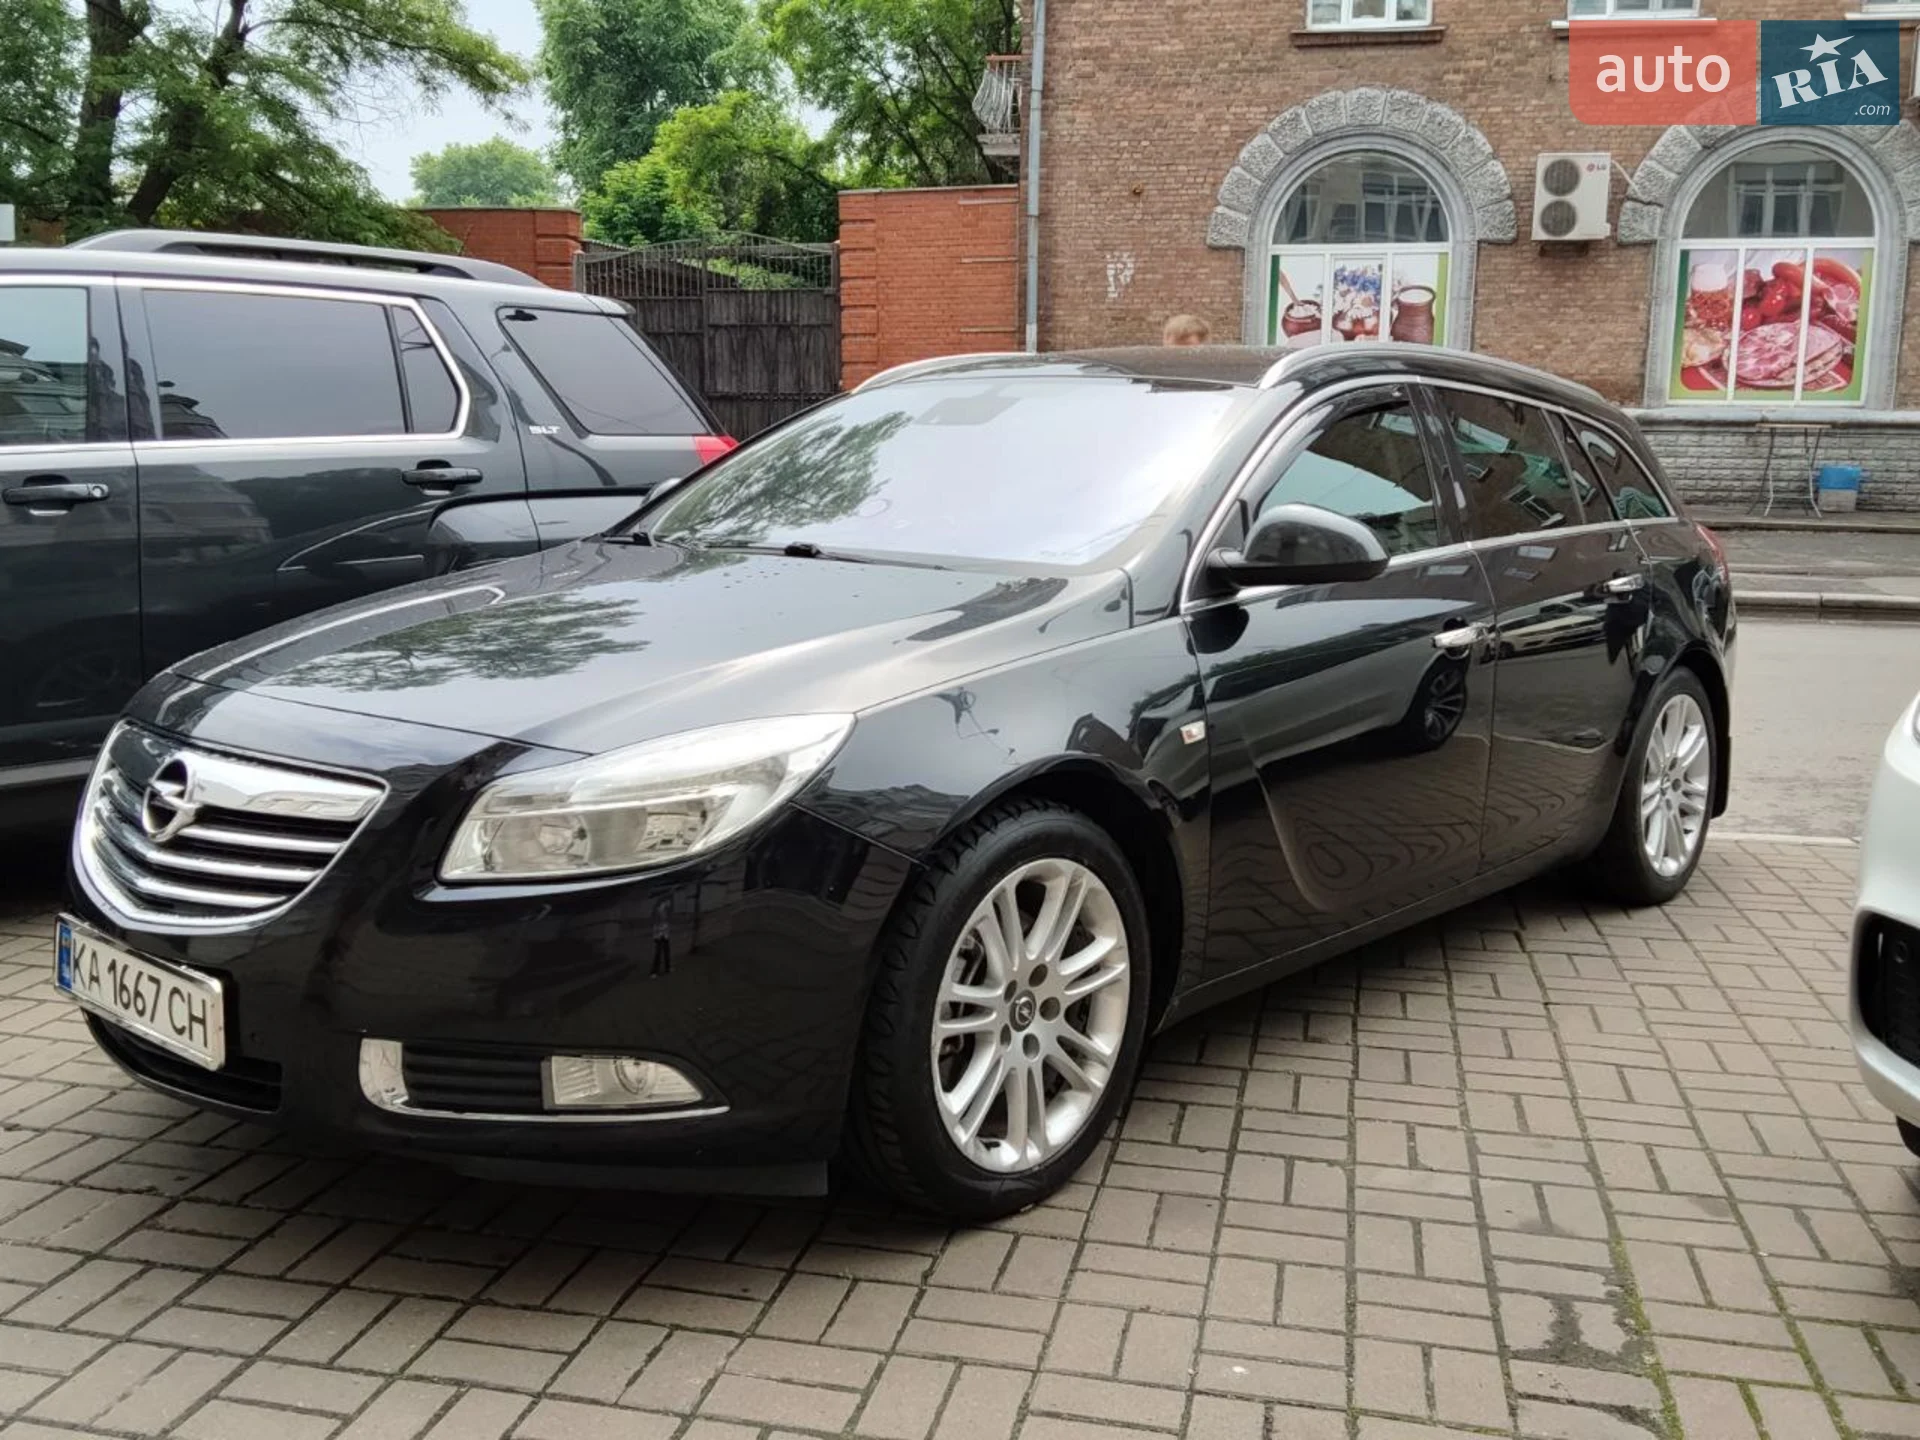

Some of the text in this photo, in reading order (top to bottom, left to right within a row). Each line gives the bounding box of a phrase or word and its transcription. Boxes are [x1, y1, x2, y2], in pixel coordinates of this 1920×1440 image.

[529, 425, 560, 434] SLT
[72, 938, 208, 1048] KA 1667 CH
